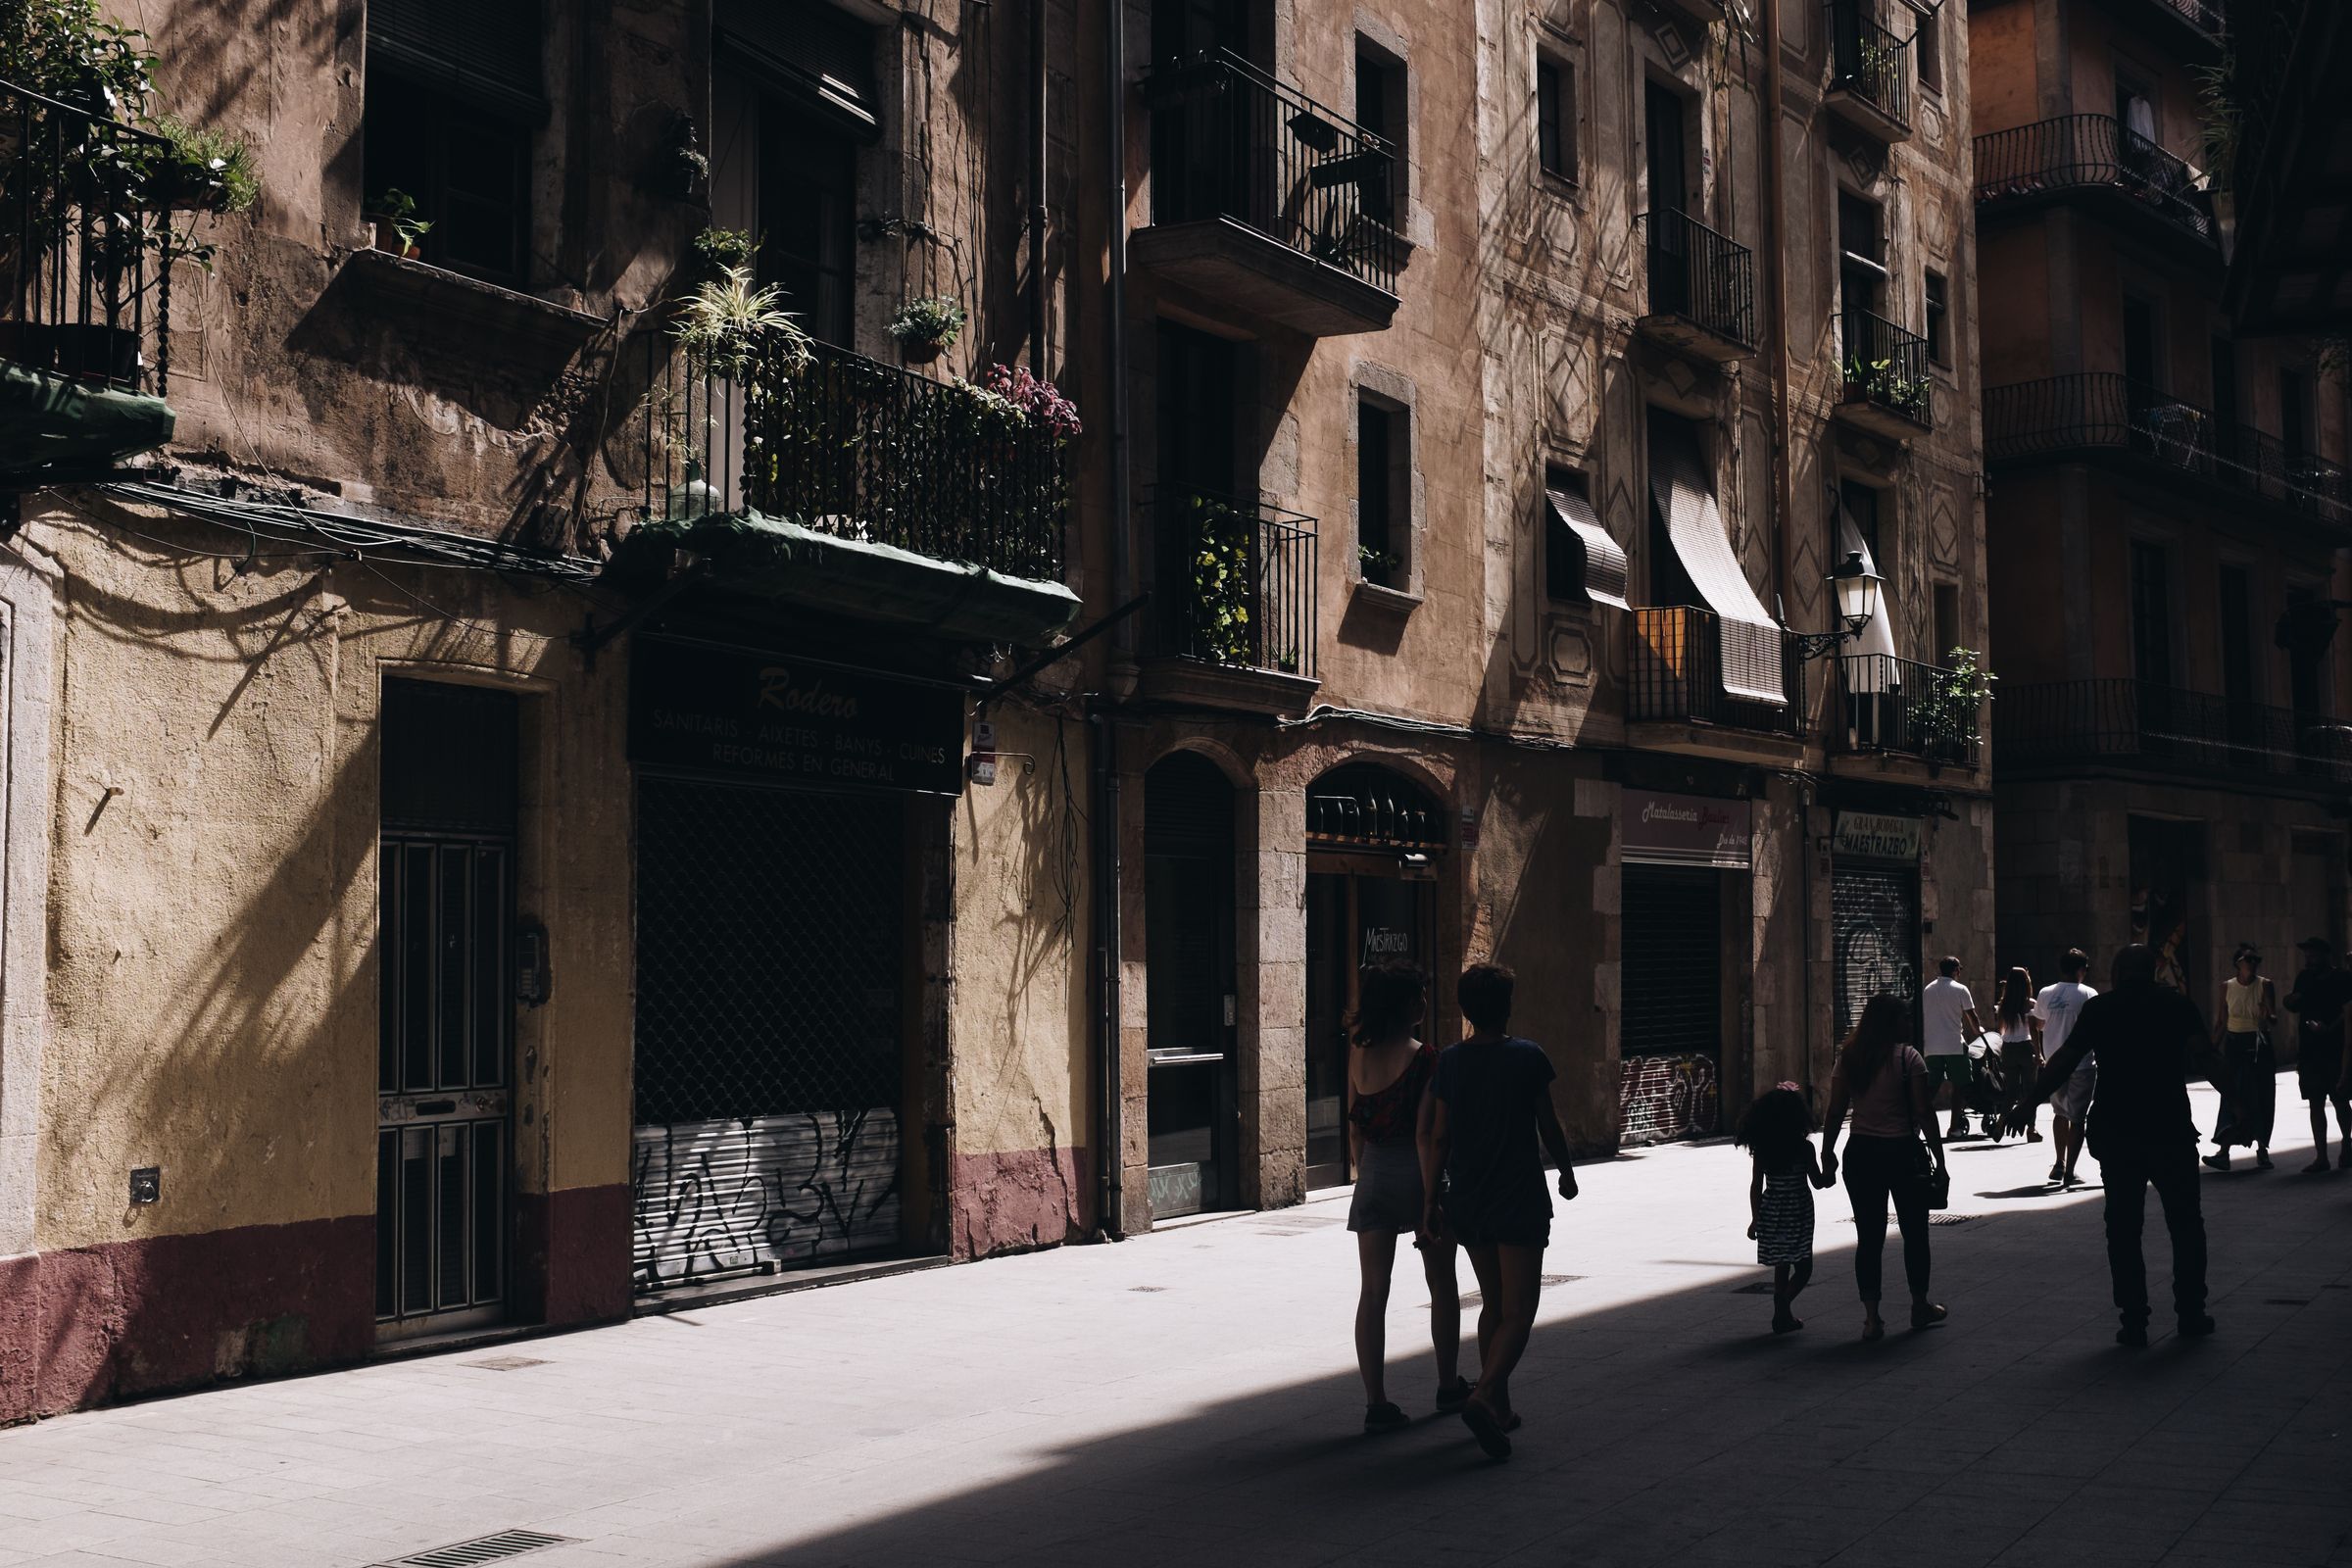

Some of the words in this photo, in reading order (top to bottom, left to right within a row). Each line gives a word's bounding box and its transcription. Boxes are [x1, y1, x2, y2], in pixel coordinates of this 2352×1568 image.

[757, 666, 858, 719] Rodero
[652, 708, 738, 737] SANITARIS
[758, 721, 818, 748] AIXETES
[834, 733, 882, 756] BANYS
[900, 743, 946, 764] CUINES
[713, 743, 796, 771] REFORMES
[803, 756, 823, 772] EN
[830, 758, 895, 782] GENERAL
[1642, 801, 1697, 823] Matalasseria
[1854, 815, 1873, 830] GRAN
[1876, 817, 1904, 833] BODEGA
[1843, 833, 1907, 856] MAESTRAZGO
